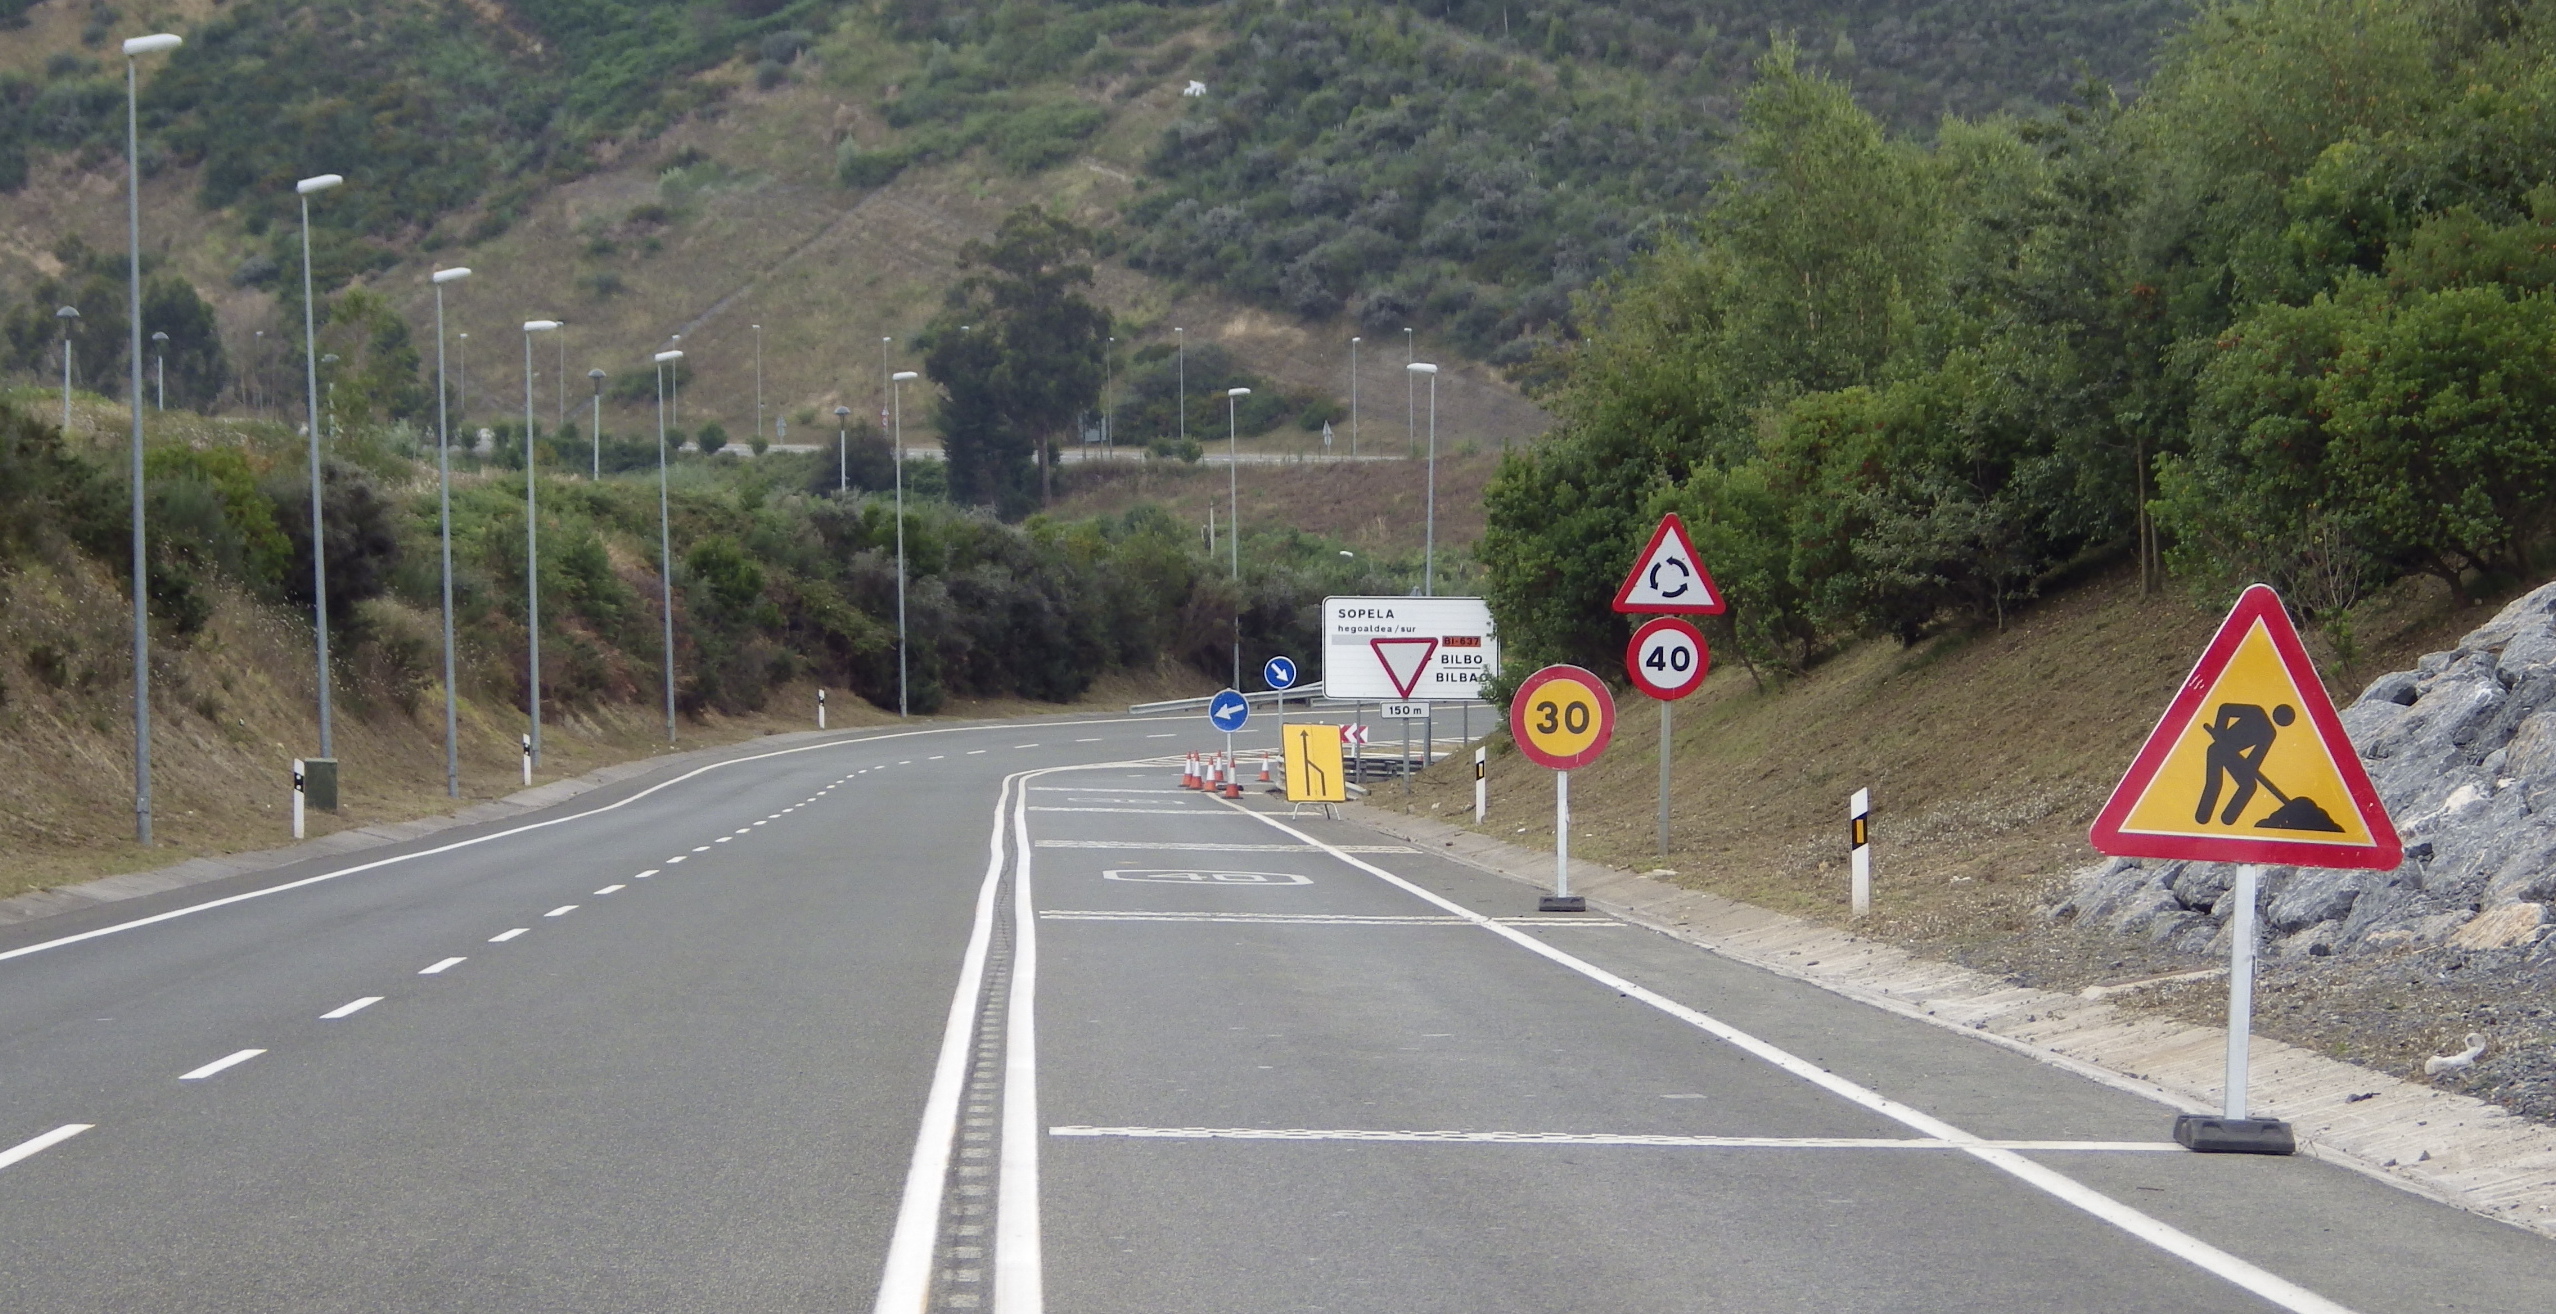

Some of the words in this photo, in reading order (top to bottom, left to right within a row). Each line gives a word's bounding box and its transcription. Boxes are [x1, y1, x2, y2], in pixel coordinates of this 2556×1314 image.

[1338, 608, 1395, 619] SOPELA
[1444, 636, 1480, 646] BI-637
[1441, 654, 1483, 664] BILBO
[1645, 645, 1691, 672] 40
[1389, 705, 1410, 715] 150
[1413, 707, 1422, 715] m
[1536, 700, 1590, 735] 30
